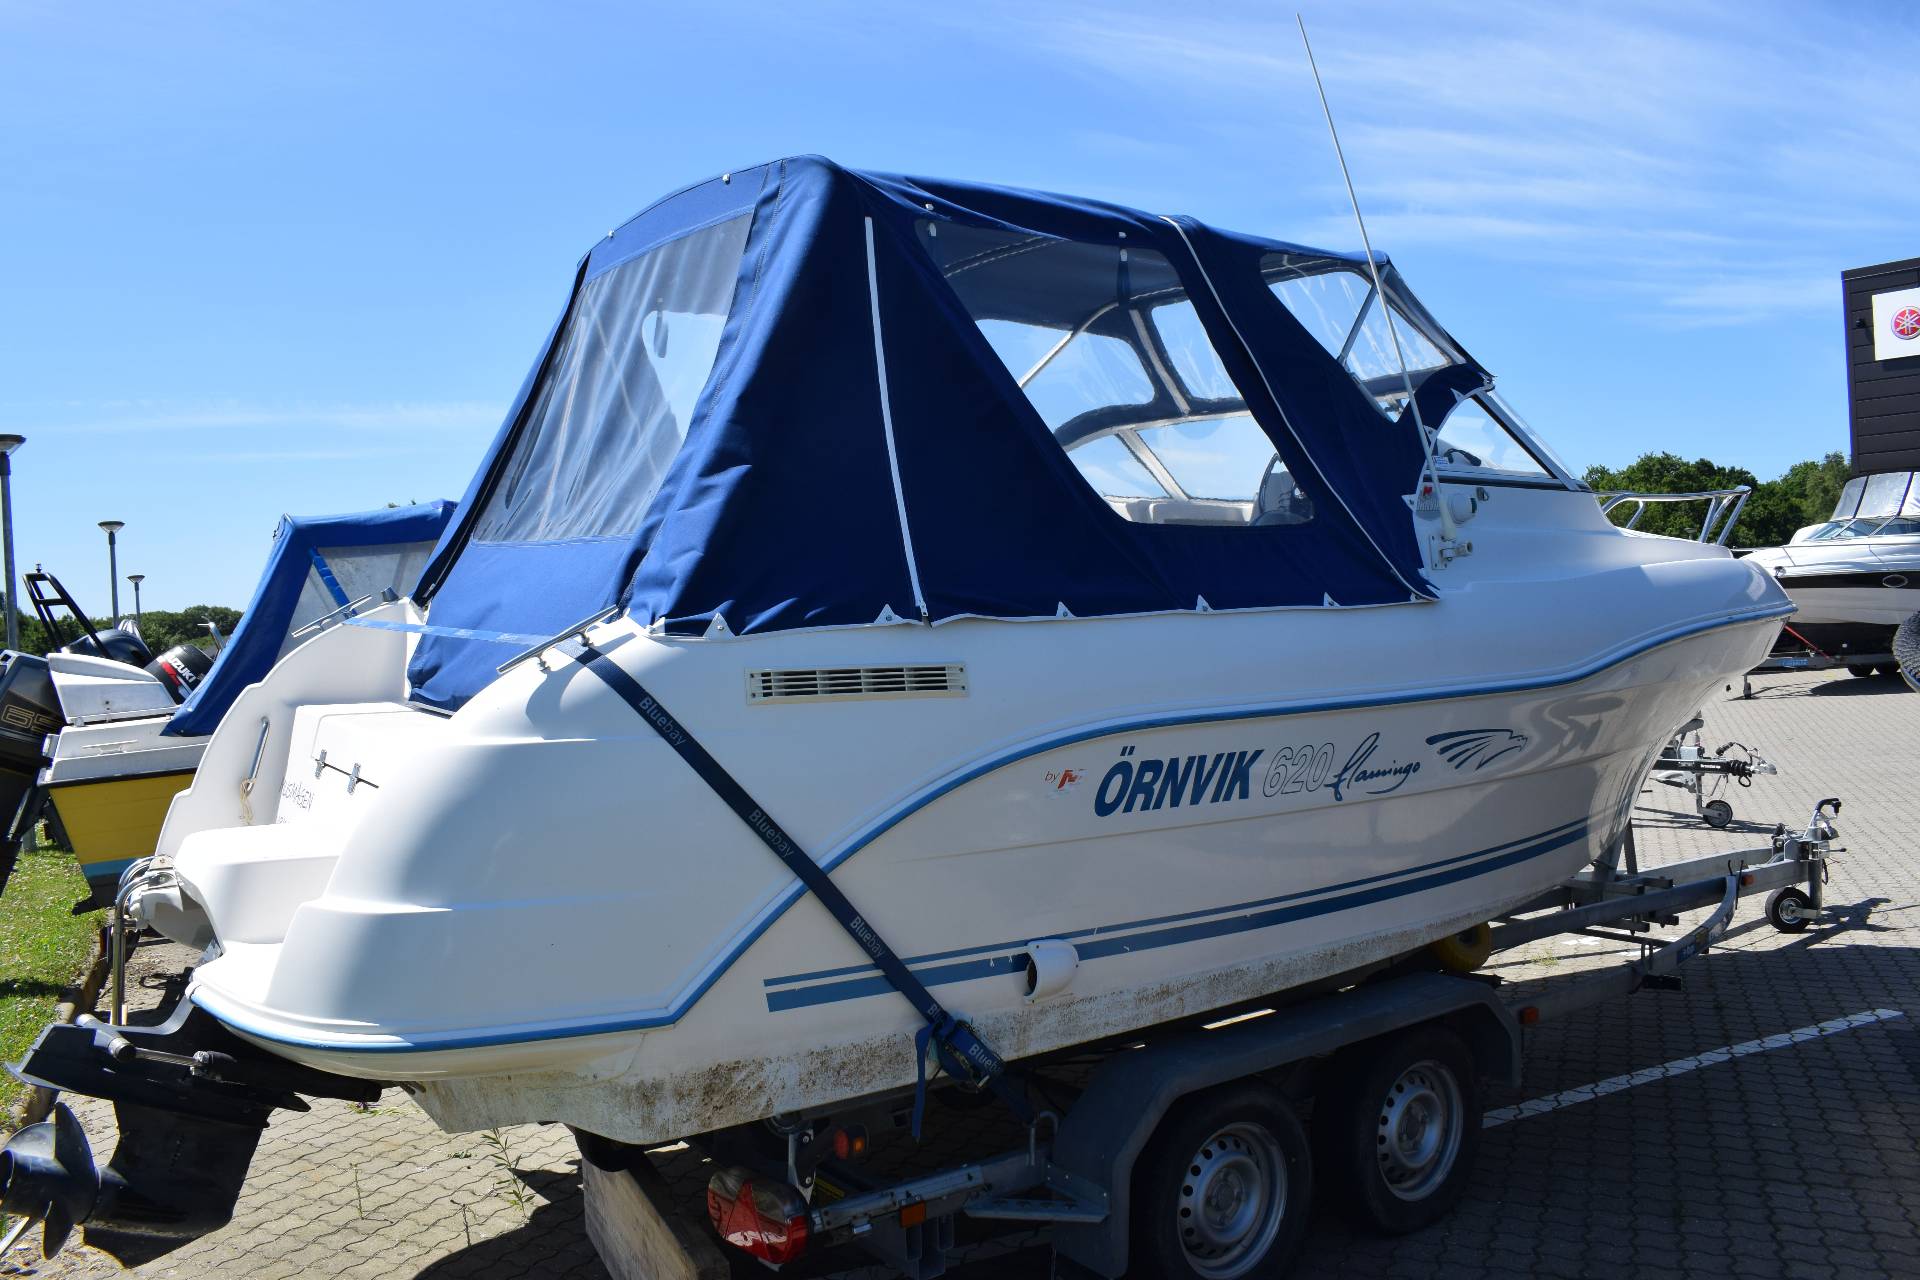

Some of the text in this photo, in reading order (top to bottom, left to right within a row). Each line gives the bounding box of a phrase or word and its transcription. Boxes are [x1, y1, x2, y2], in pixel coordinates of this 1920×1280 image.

[163, 654, 195, 682] UZUKI
[639, 697, 687, 746] Bluebay
[1044, 770, 1060, 783] by
[1094, 746, 1265, 817] ÖRNVIK
[1263, 742, 1335, 798] 620
[749, 809, 794, 858] Bluebay
[850, 916, 886, 958] Bluebay
